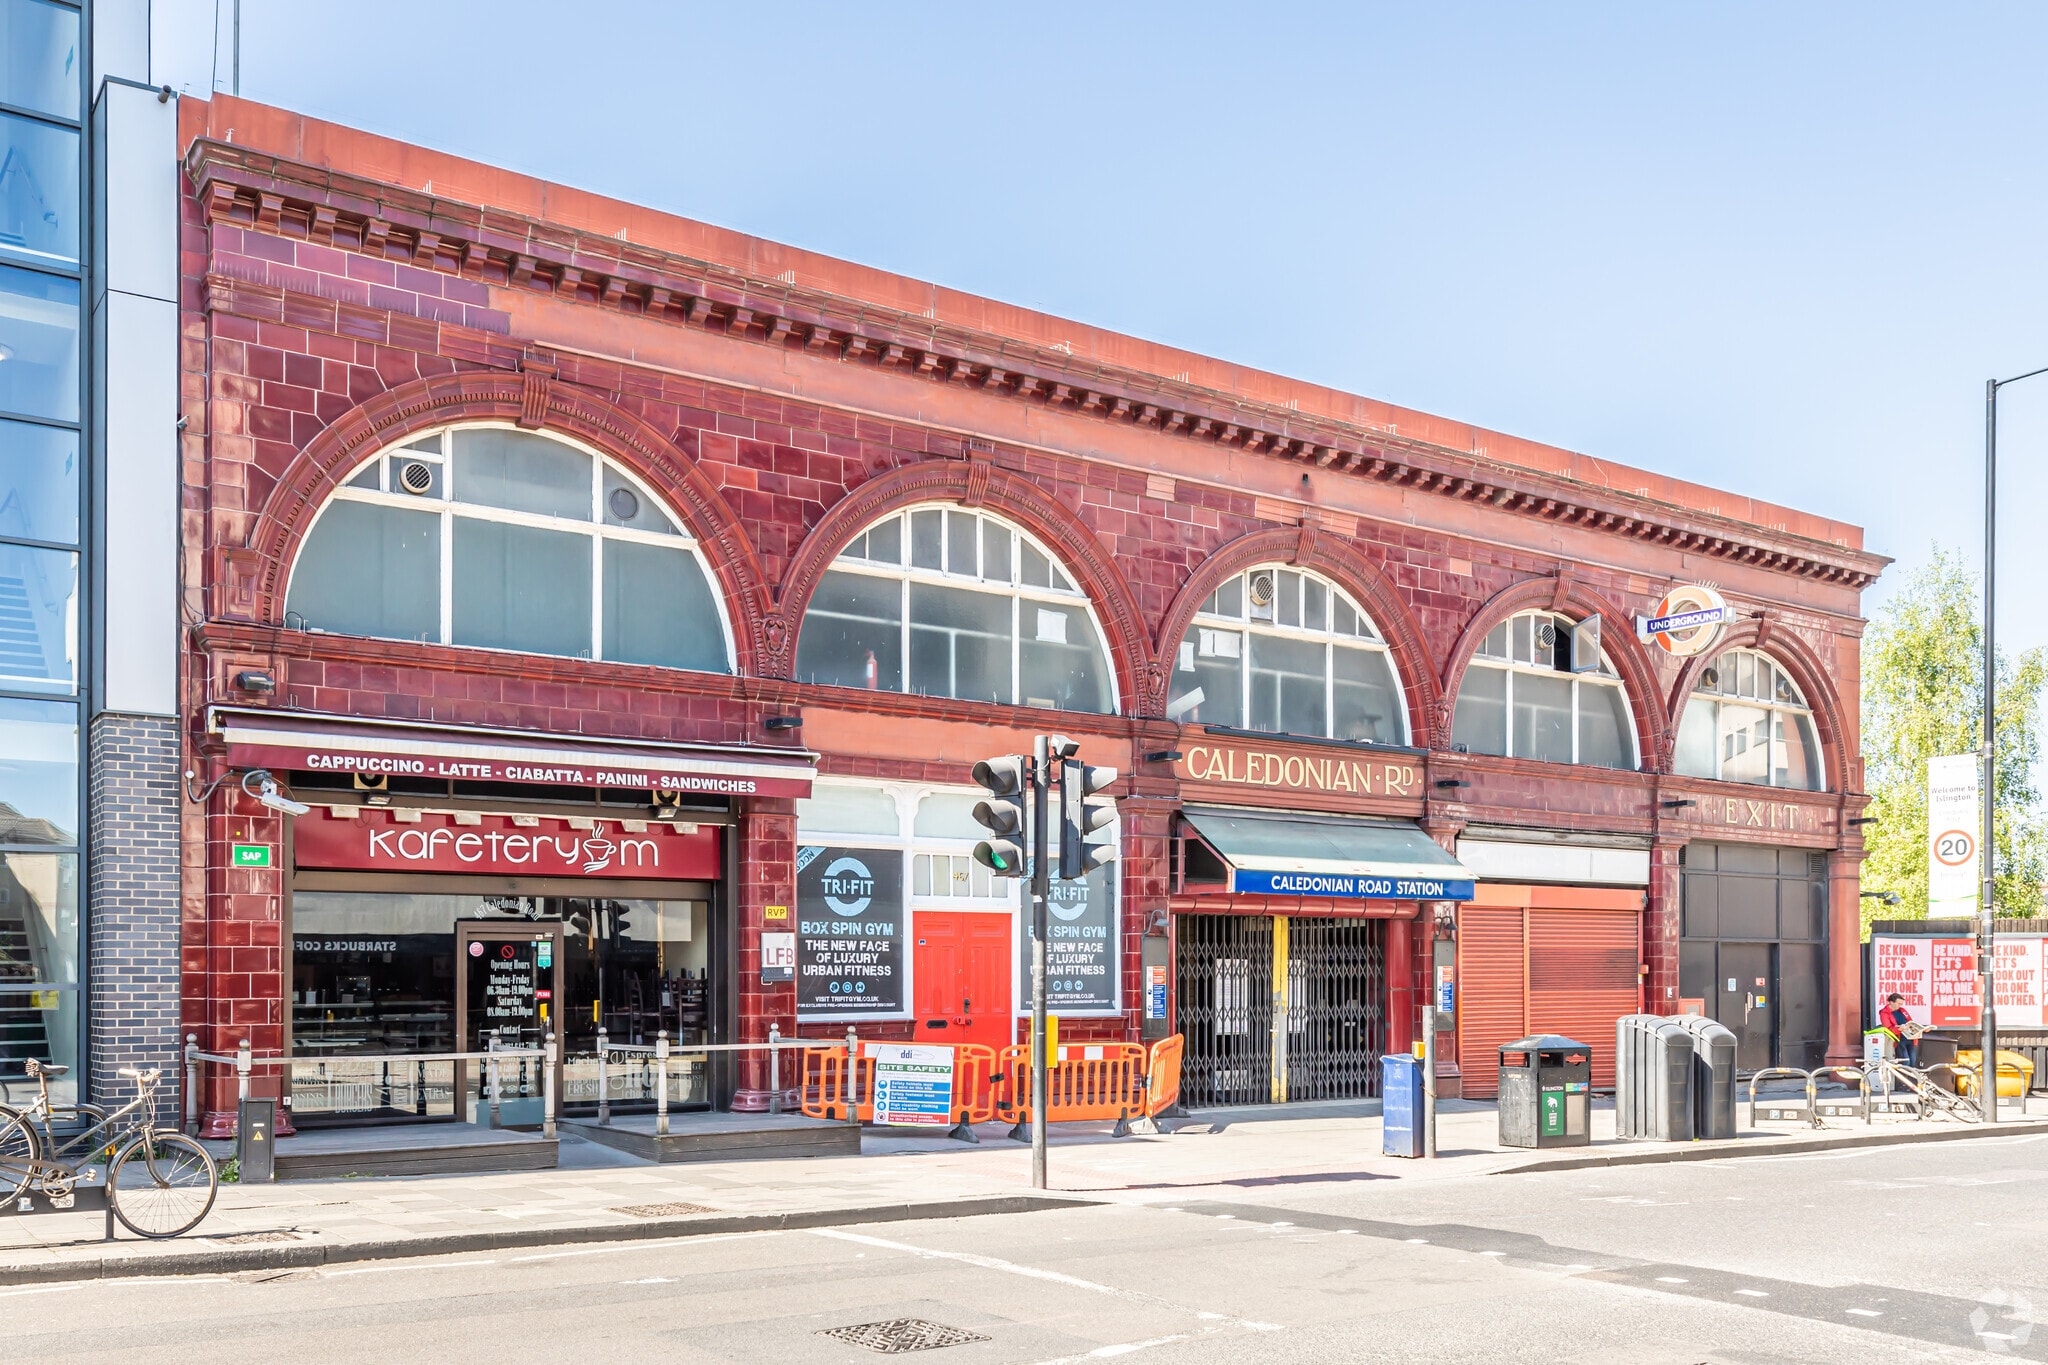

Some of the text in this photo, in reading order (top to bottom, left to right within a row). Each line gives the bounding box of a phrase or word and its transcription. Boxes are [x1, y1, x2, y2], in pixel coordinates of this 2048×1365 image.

[1650, 611, 1720, 630] UNDERGROUND
[307, 754, 424, 773] CAPPUCCINO
[438, 762, 492, 778] LATTE
[505, 767, 584, 783] CIABATTA
[596, 772, 648, 787] PANINI
[660, 776, 757, 793] SANDWICHES
[1187, 746, 1372, 794] CALEDONIAN
[1931, 786, 1965, 794] Welcome
[1936, 794, 1971, 803] Islington
[1725, 798, 1800, 830] EXIT
[1941, 839, 1968, 856] 20
[242, 851, 262, 861] SAP
[1271, 875, 1444, 896] CALEDONIAN ROAD STATION
[485, 896, 525, 913] Caledonian
[523, 902, 543, 921] Road
[767, 908, 785, 916] RVP
[801, 921, 893, 936] BOX SPIN GYM
[1054, 926, 1080, 938] SPIN
[1082, 926, 1107, 938] GYM
[805, 939, 890, 952] THE NEW FACE
[1053, 942, 1076, 953] NEW
[1078, 943, 1104, 953] FACE
[1879, 944, 1918, 956] BE KIND.
[1933, 944, 1973, 957] BE KIND.
[2003, 945, 2029, 956] KIND.
[766, 948, 794, 965] LFB
[816, 953, 879, 964] OF LUXURY
[1056, 954, 1094, 965] LUXURY
[490, 959, 530, 971] Opening Hours
[1879, 957, 1906, 968] LET'S
[1933, 957, 1962, 969] LET'S
[802, 965, 891, 976] URBAN FITNESS
[1065, 965, 1106, 976] FITNESS
[1879, 970, 1924, 981] LOOK OUT
[1933, 970, 1979, 981] LOOK OUT
[2016, 970, 2035, 981] OUT
[1879, 982, 1918, 993] FOR ONE
[1933, 982, 1974, 994] FOR ONE
[2011, 982, 2029, 993] ONE
[497, 996, 522, 1006] Saturday
[499, 1024, 521, 1034] Contact
[900, 1050, 913, 1059] ddi
[906, 1065, 950, 1073] SAFETY
